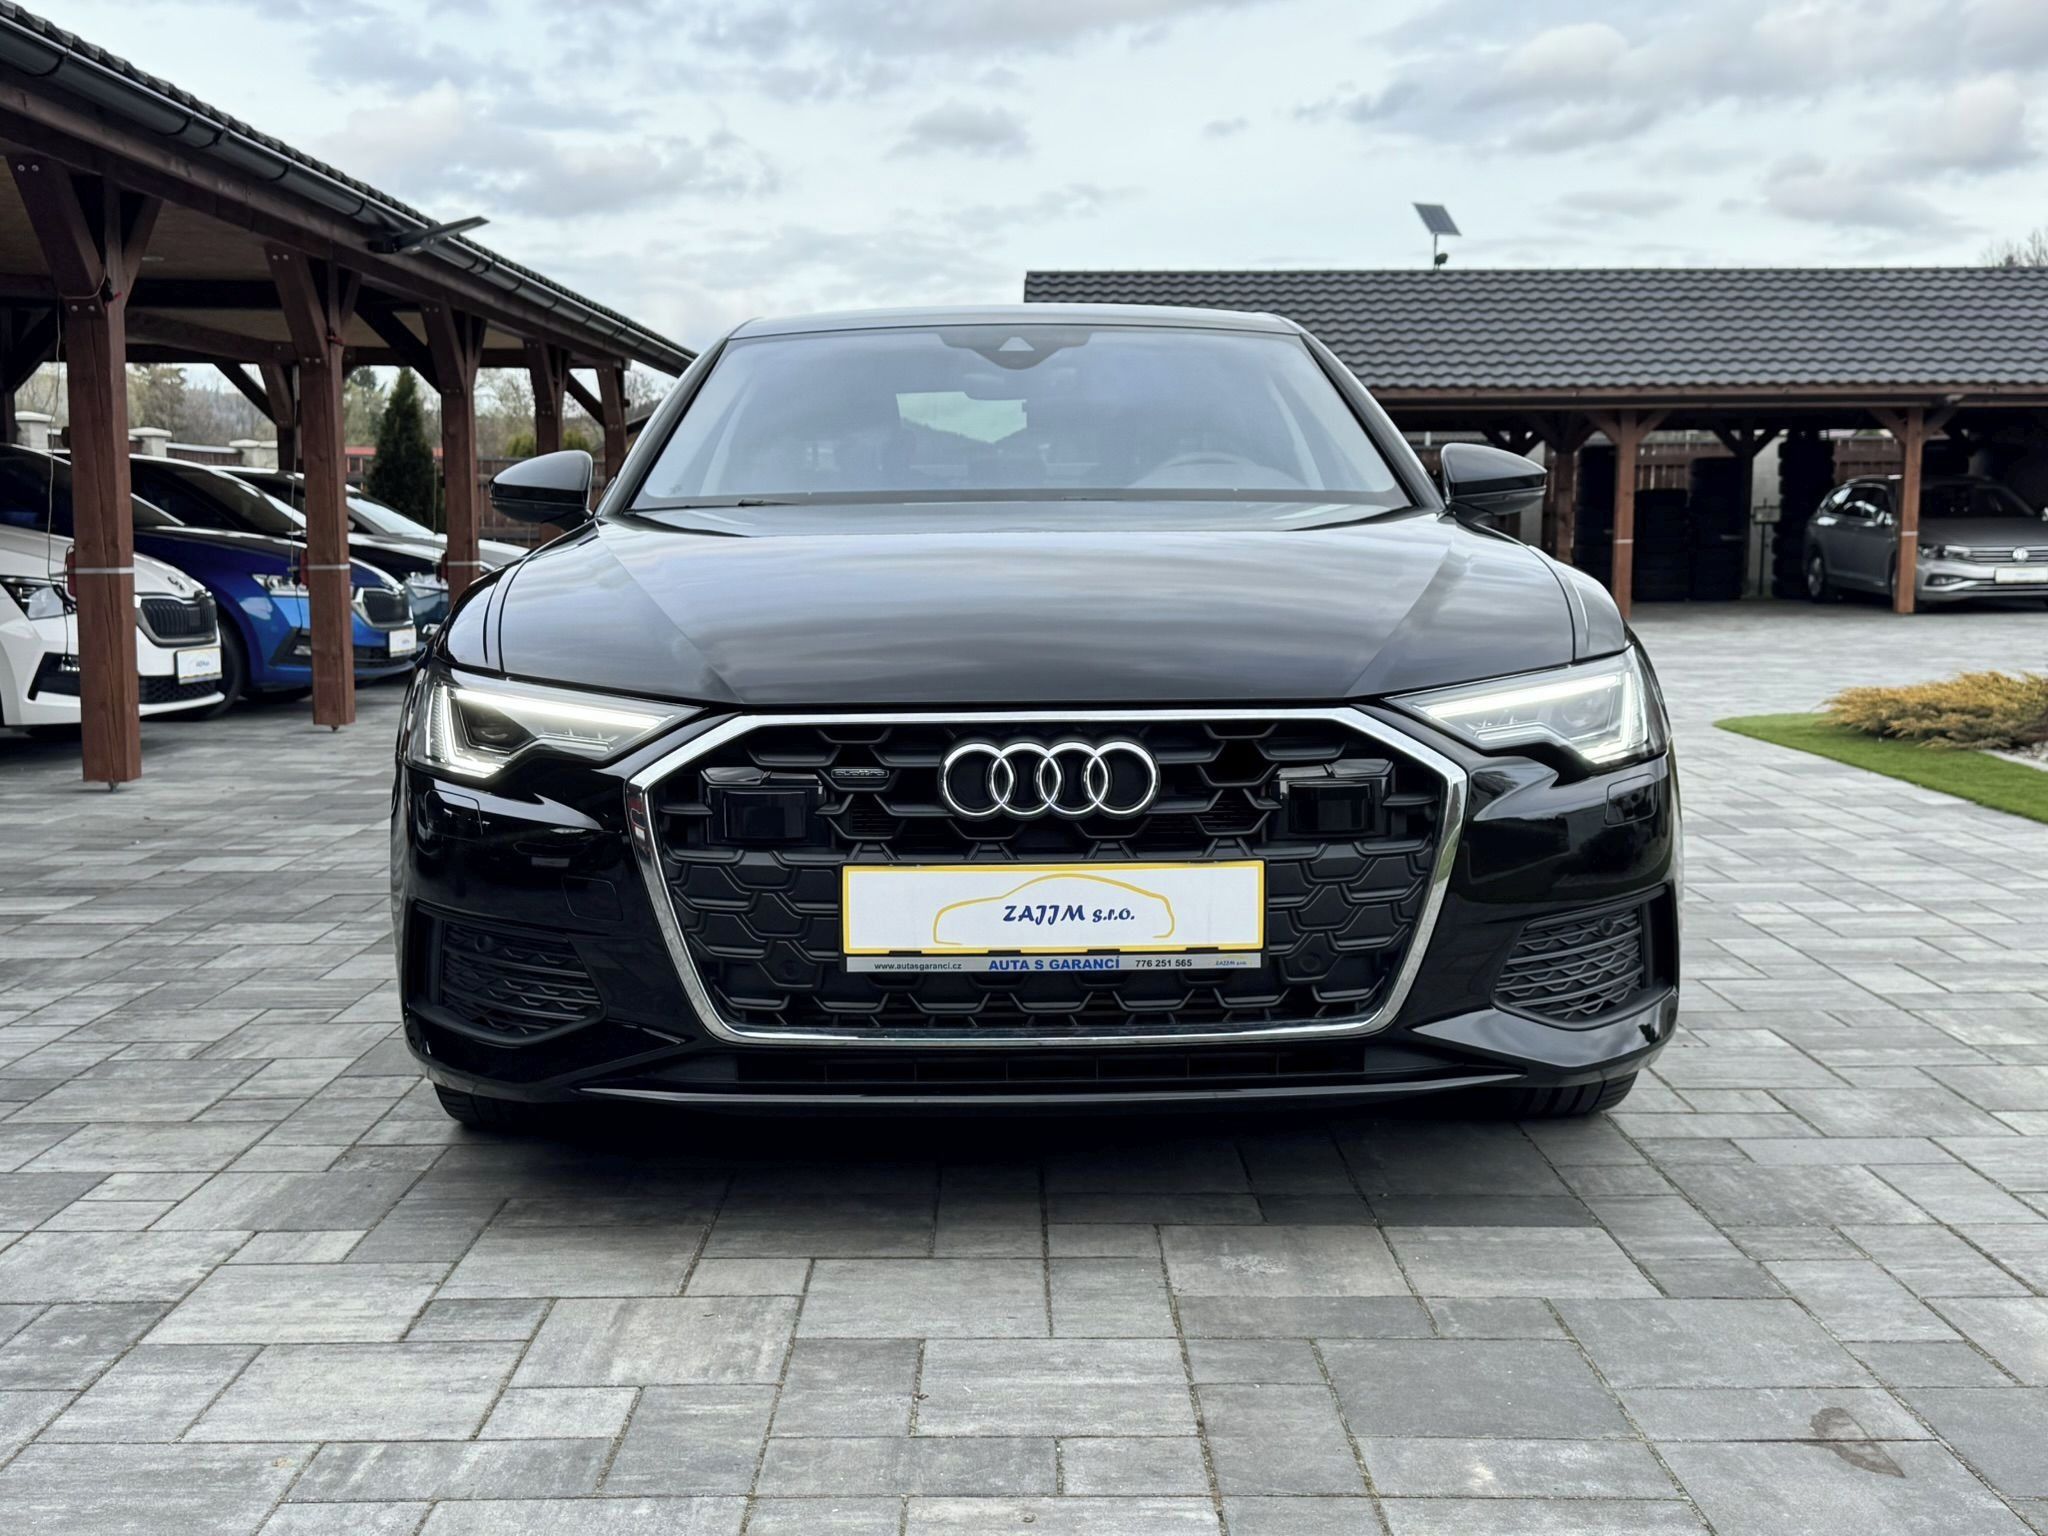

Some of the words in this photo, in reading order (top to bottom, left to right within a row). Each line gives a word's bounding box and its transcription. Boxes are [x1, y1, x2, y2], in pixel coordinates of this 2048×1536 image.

[1003, 904, 1086, 926] ZAJJM
[1092, 907, 1135, 923] s.r.o.
[873, 962, 963, 971] www.autasgaranci.cz
[988, 959, 1030, 971] AUTA
[1034, 959, 1045, 970] S
[1135, 959, 1153, 968] 776
[1155, 959, 1172, 968] 251
[1175, 958, 1193, 968] 565
